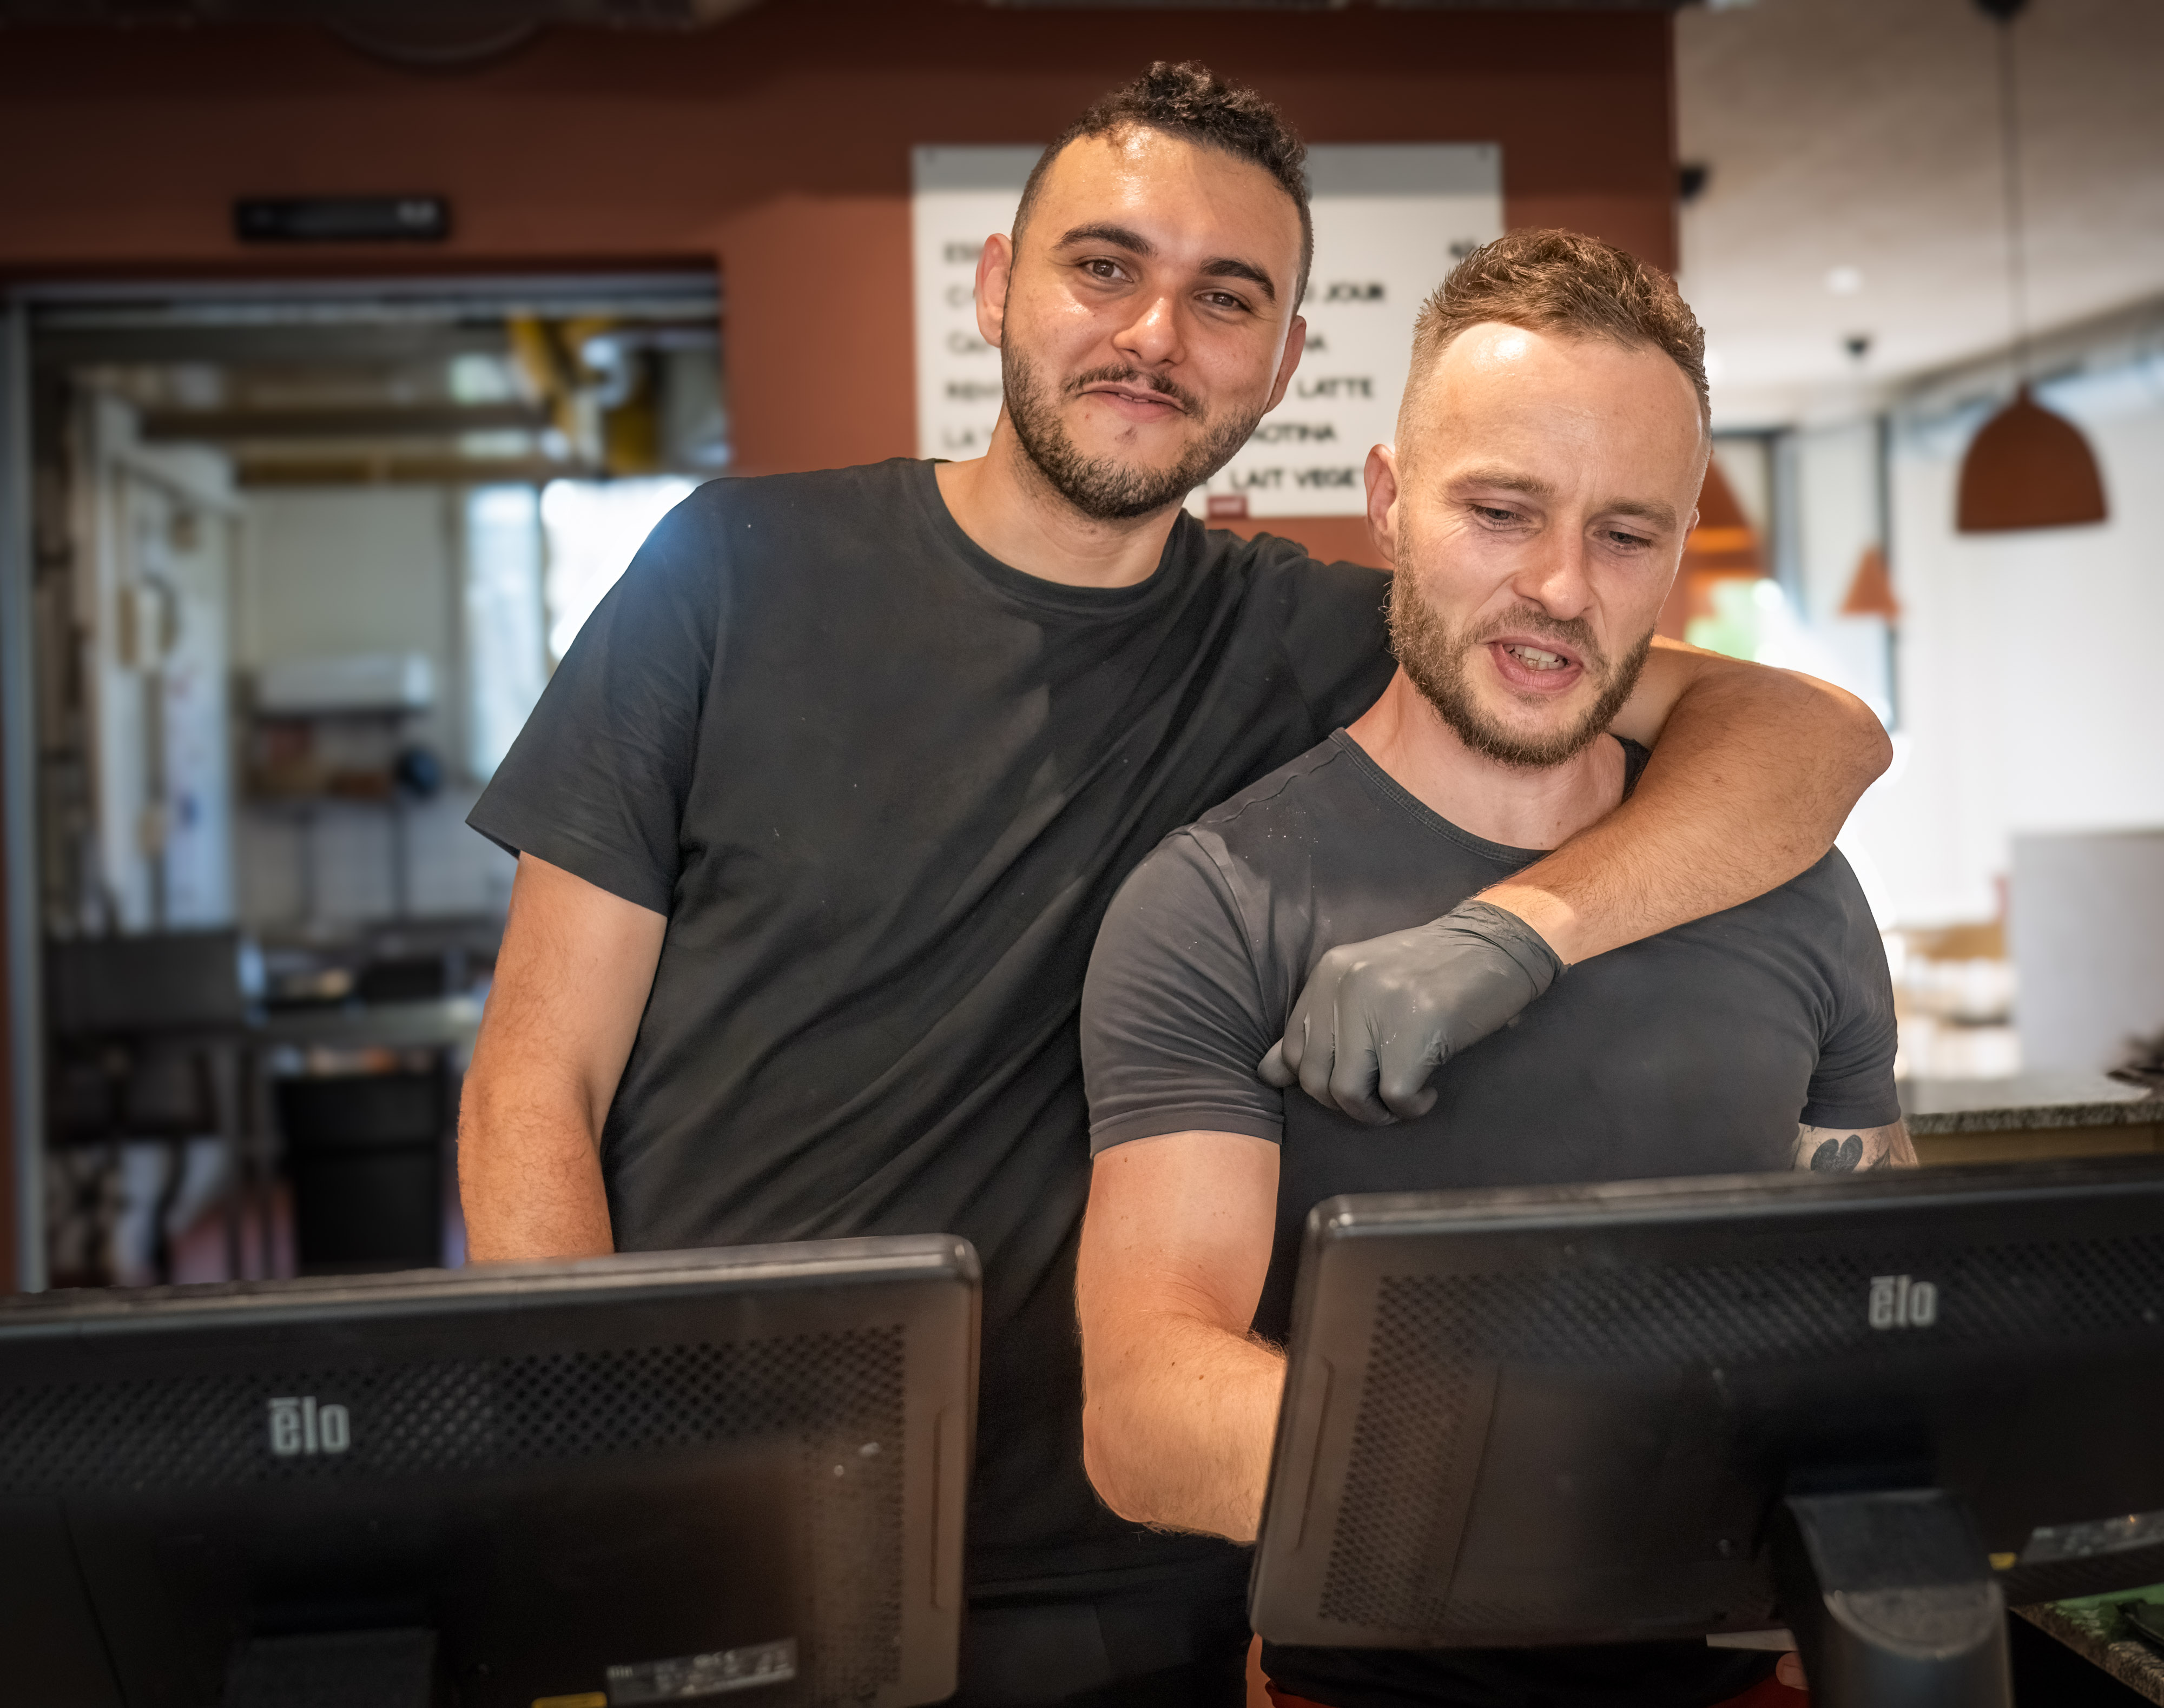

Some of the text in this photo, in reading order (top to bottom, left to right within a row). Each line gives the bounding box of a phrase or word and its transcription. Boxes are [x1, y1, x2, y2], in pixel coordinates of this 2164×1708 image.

[1327, 281, 1384, 304] JOUR
[1297, 376, 1373, 400] LATTE
[1230, 468, 1283, 491] LAIT
